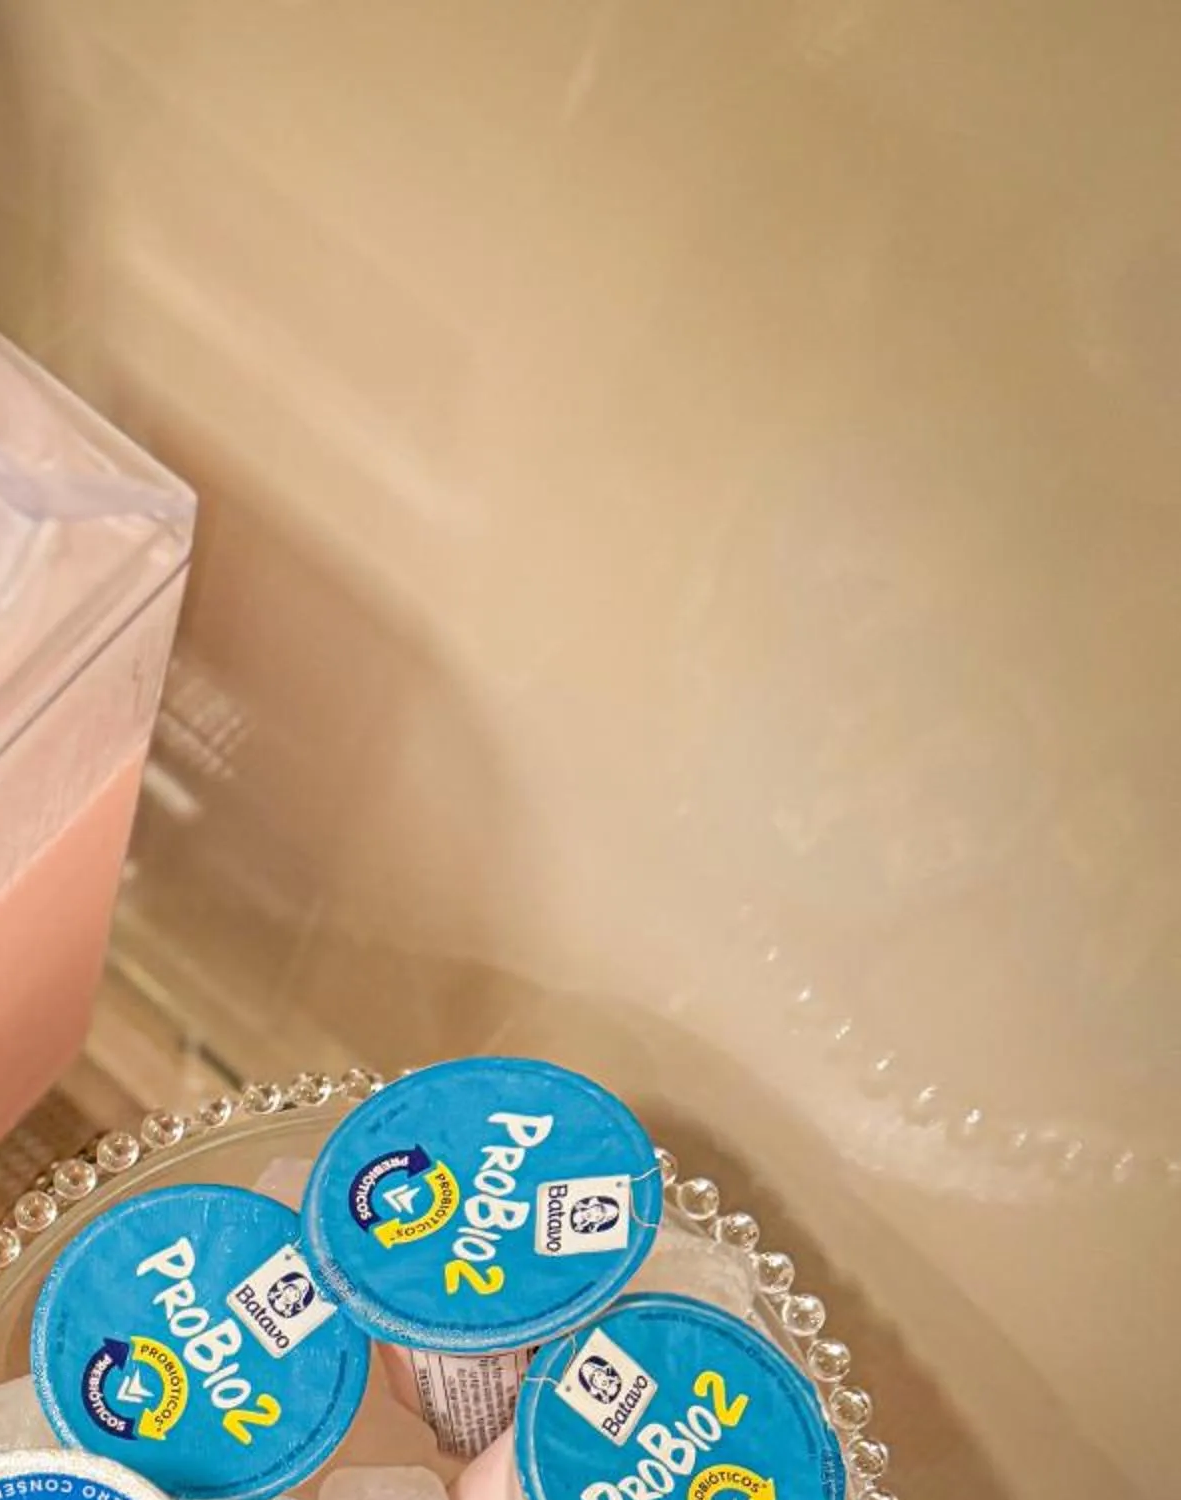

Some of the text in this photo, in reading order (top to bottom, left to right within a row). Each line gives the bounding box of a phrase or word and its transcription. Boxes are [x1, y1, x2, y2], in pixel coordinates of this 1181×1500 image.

[546, 1183, 568, 1253] Batavo
[235, 1283, 291, 1350] Batavo
[601, 1374, 649, 1437] Batavo
